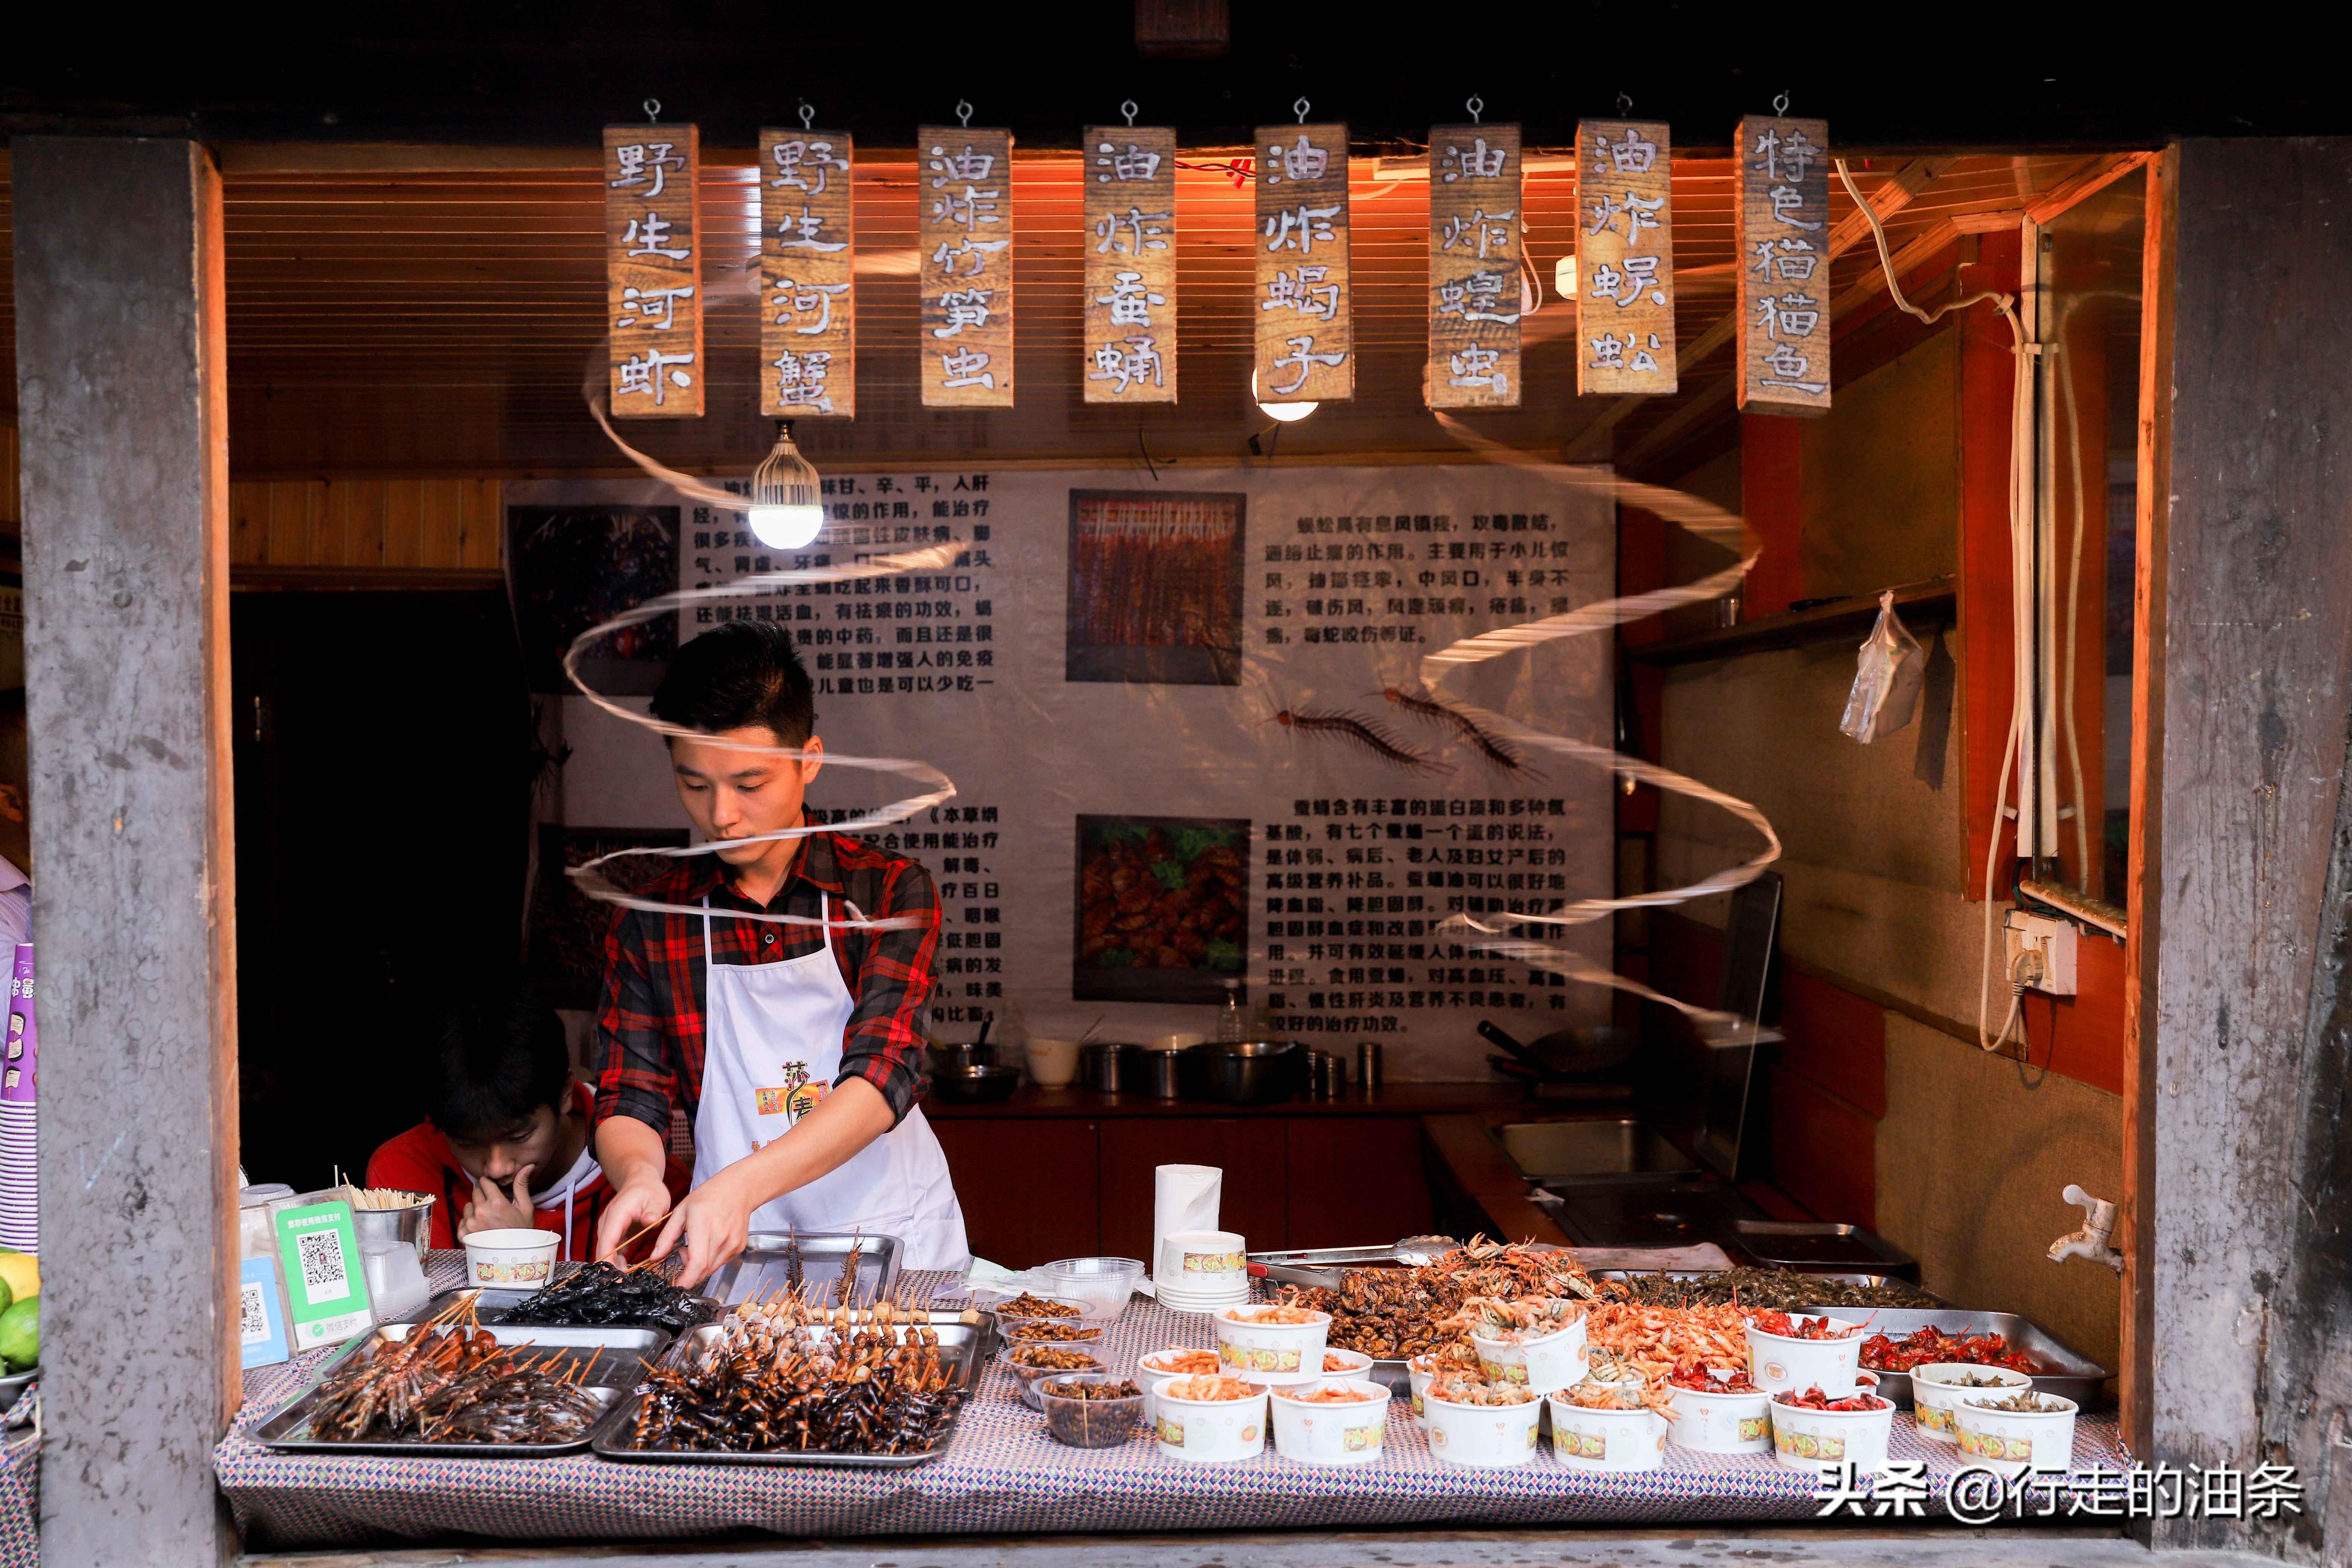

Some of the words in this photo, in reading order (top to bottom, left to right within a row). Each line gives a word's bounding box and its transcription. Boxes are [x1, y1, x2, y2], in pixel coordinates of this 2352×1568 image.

[610, 142, 696, 406] 野生河虾
[770, 139, 851, 414] 野生河蟹
[930, 144, 1012, 390] 油炸竹笋虫
[1088, 142, 1172, 394] 油炸蚕蛹
[1261, 134, 1346, 395] 油炸蝎子
[1441, 137, 1521, 395] 油炸蝗虫
[1588, 128, 1667, 373] 油炸蜈蚣
[1754, 127, 1828, 394] 特色猫猫鱼
[326, 1318, 358, 1333] 微信支付
